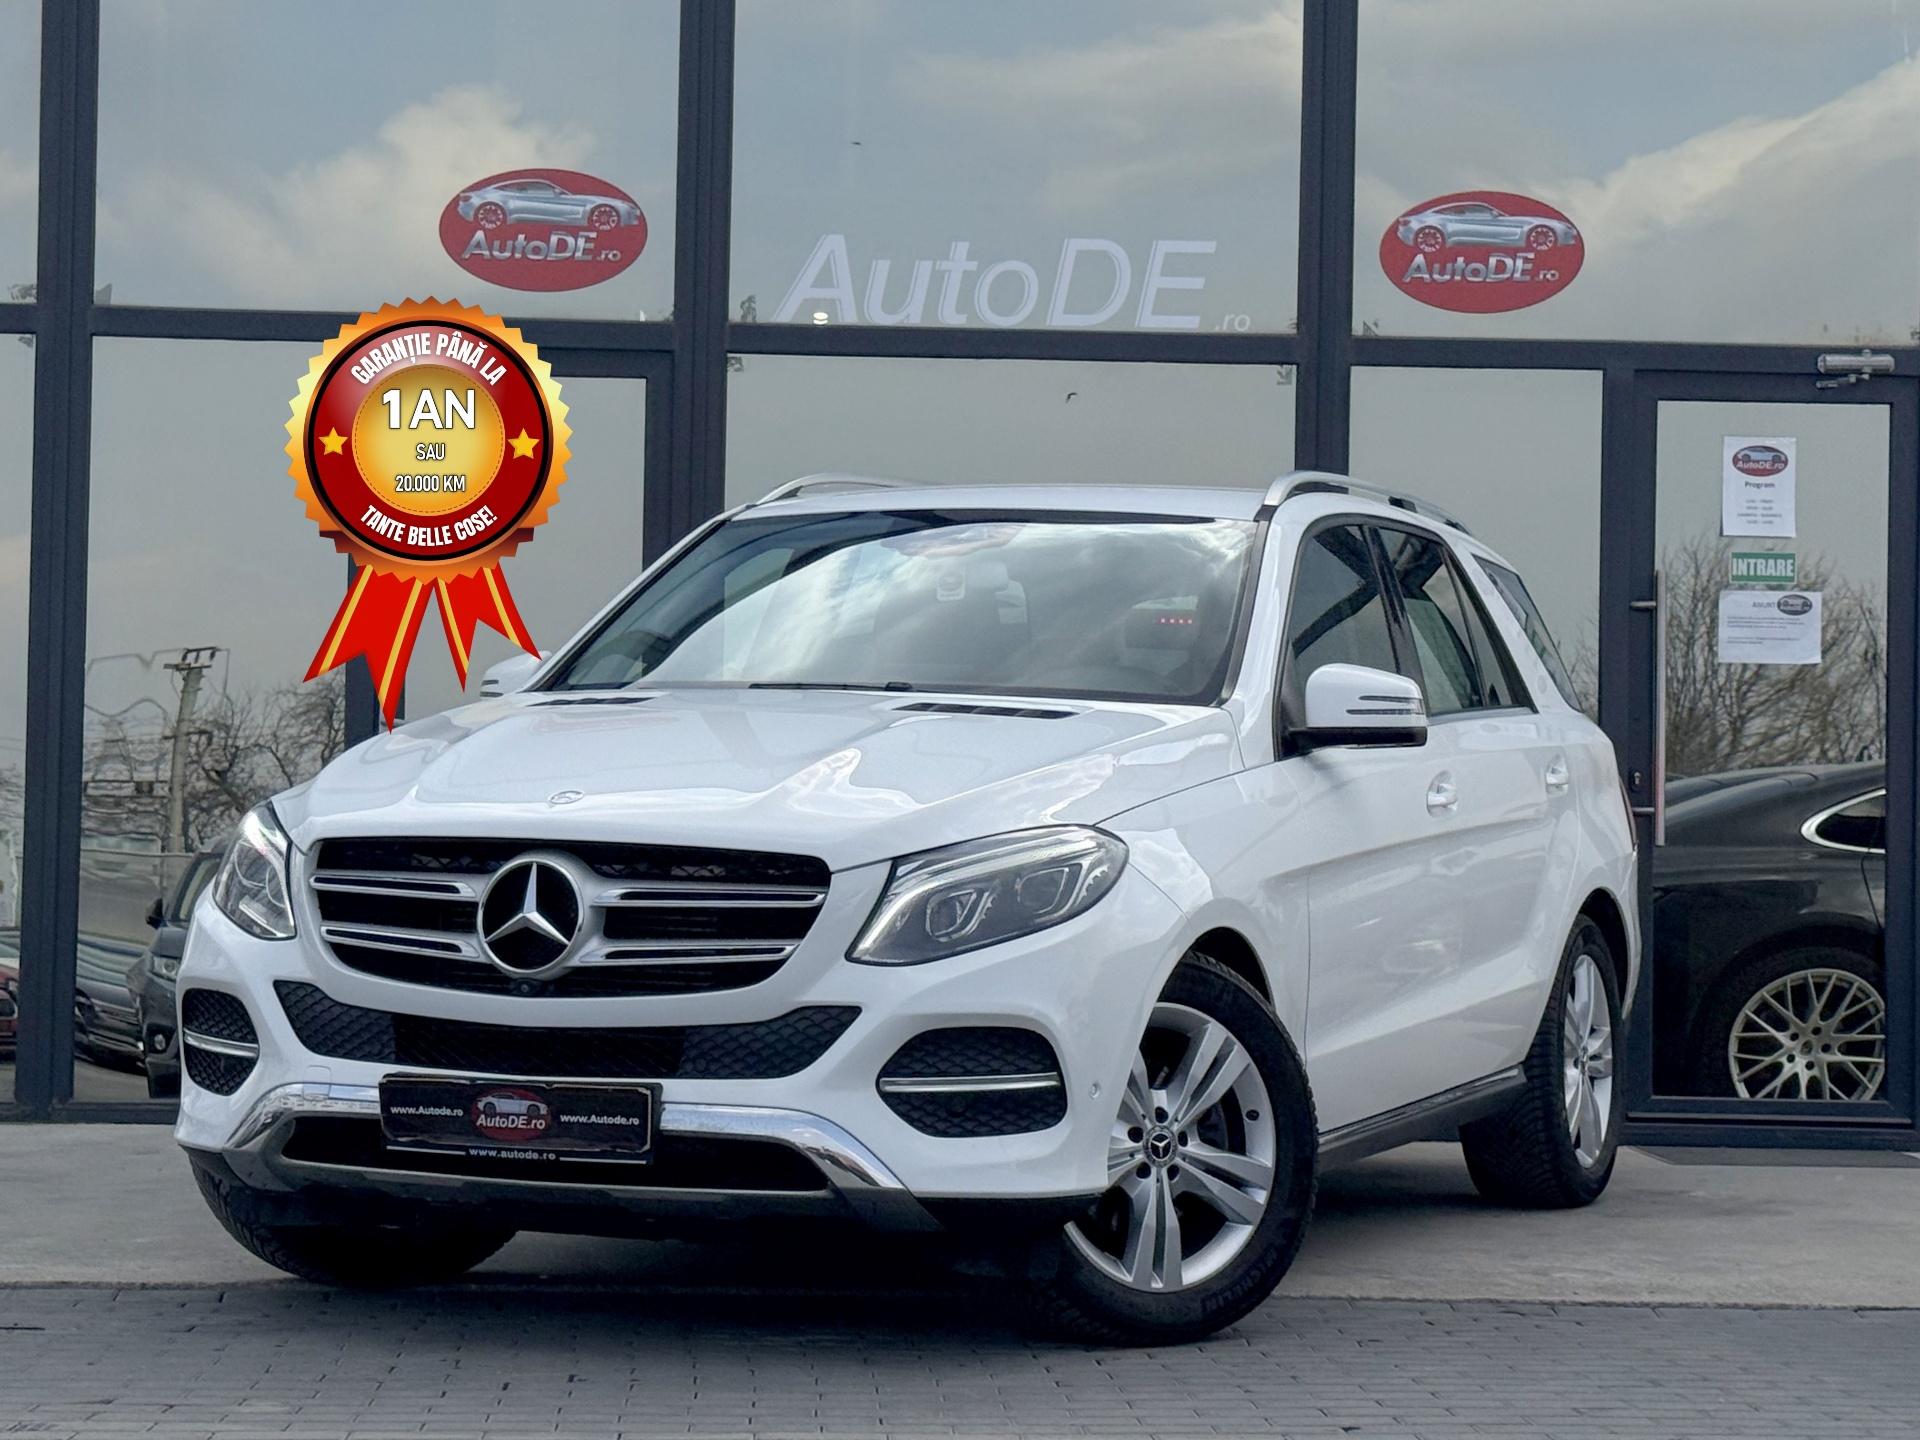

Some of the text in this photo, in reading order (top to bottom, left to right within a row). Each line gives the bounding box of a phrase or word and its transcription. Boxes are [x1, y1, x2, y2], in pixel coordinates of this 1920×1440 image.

[1744, 481, 1776, 490] Program
[1732, 558, 1794, 577] INTRARE
[390, 1105, 464, 1117] www.Autode.ro
[476, 1113, 546, 1130] AutoDE.ro
[560, 1113, 639, 1126] www.Autode.ro
[468, 1147, 556, 1161] www.autode.ro
